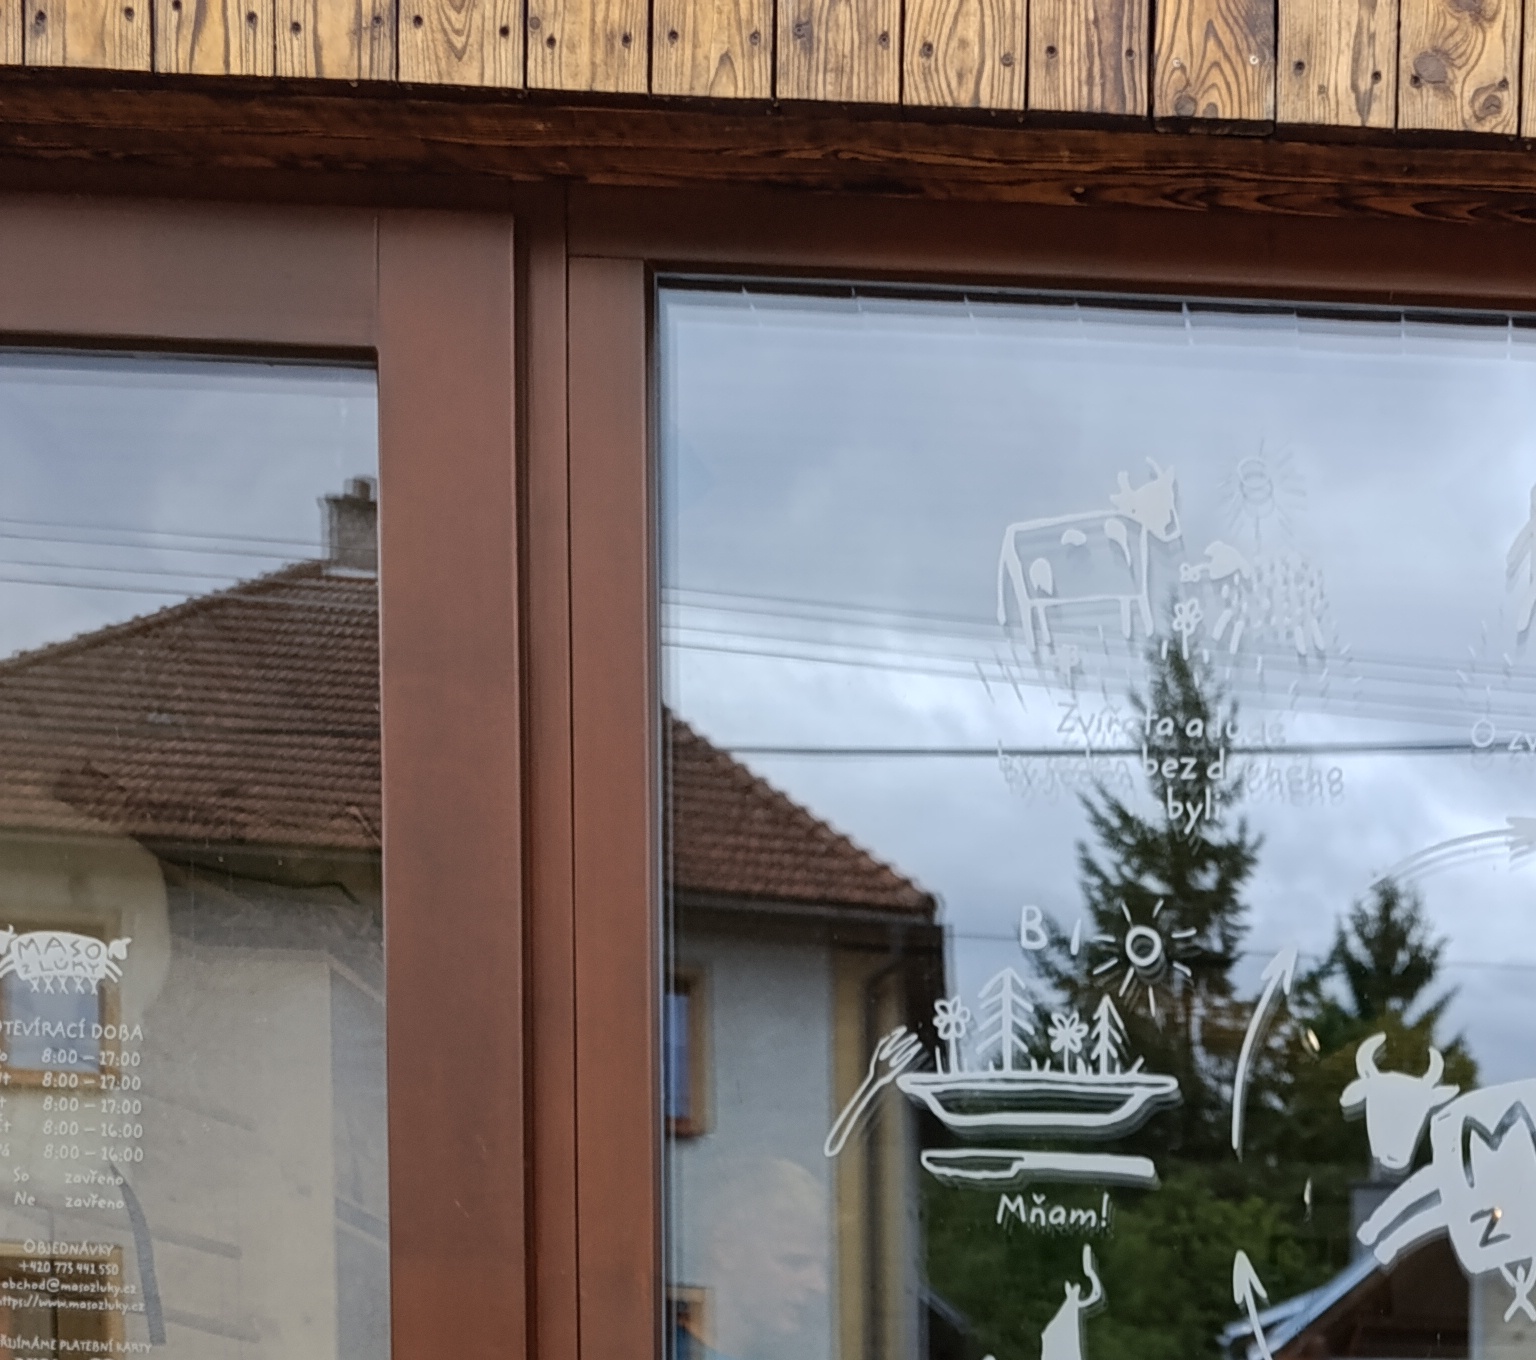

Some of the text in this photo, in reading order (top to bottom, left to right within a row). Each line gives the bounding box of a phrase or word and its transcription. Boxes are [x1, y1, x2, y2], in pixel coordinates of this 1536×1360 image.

[1185, 716, 1204, 739] a
[1143, 743, 1198, 781] bez
[17, 937, 102, 960] MASO
[0, 1016, 144, 1042] TEVÍRACÍ DOBA
[41, 1047, 78, 1064] 8:00
[100, 1051, 141, 1067] 17:00
[42, 1071, 79, 1088] 8:00
[100, 1074, 142, 1091] 17:00
[42, 1095, 79, 1112] 8:00
[101, 1098, 142, 1115] 17:00
[42, 1119, 79, 1136] 8:00
[101, 1122, 143, 1139] 16:00
[43, 1143, 80, 1160] 8:00
[101, 1146, 144, 1163] 16:00
[13, 1166, 124, 1186] So zavřeno
[13, 1191, 125, 1210] Ne zavřeno
[996, 1190, 1109, 1229] Mňam!
[23, 1238, 115, 1256] OBJEDNÁVKY
[18, 1259, 51, 1273] +420
[0, 1334, 56, 1351] ŘIJÍMÁME
